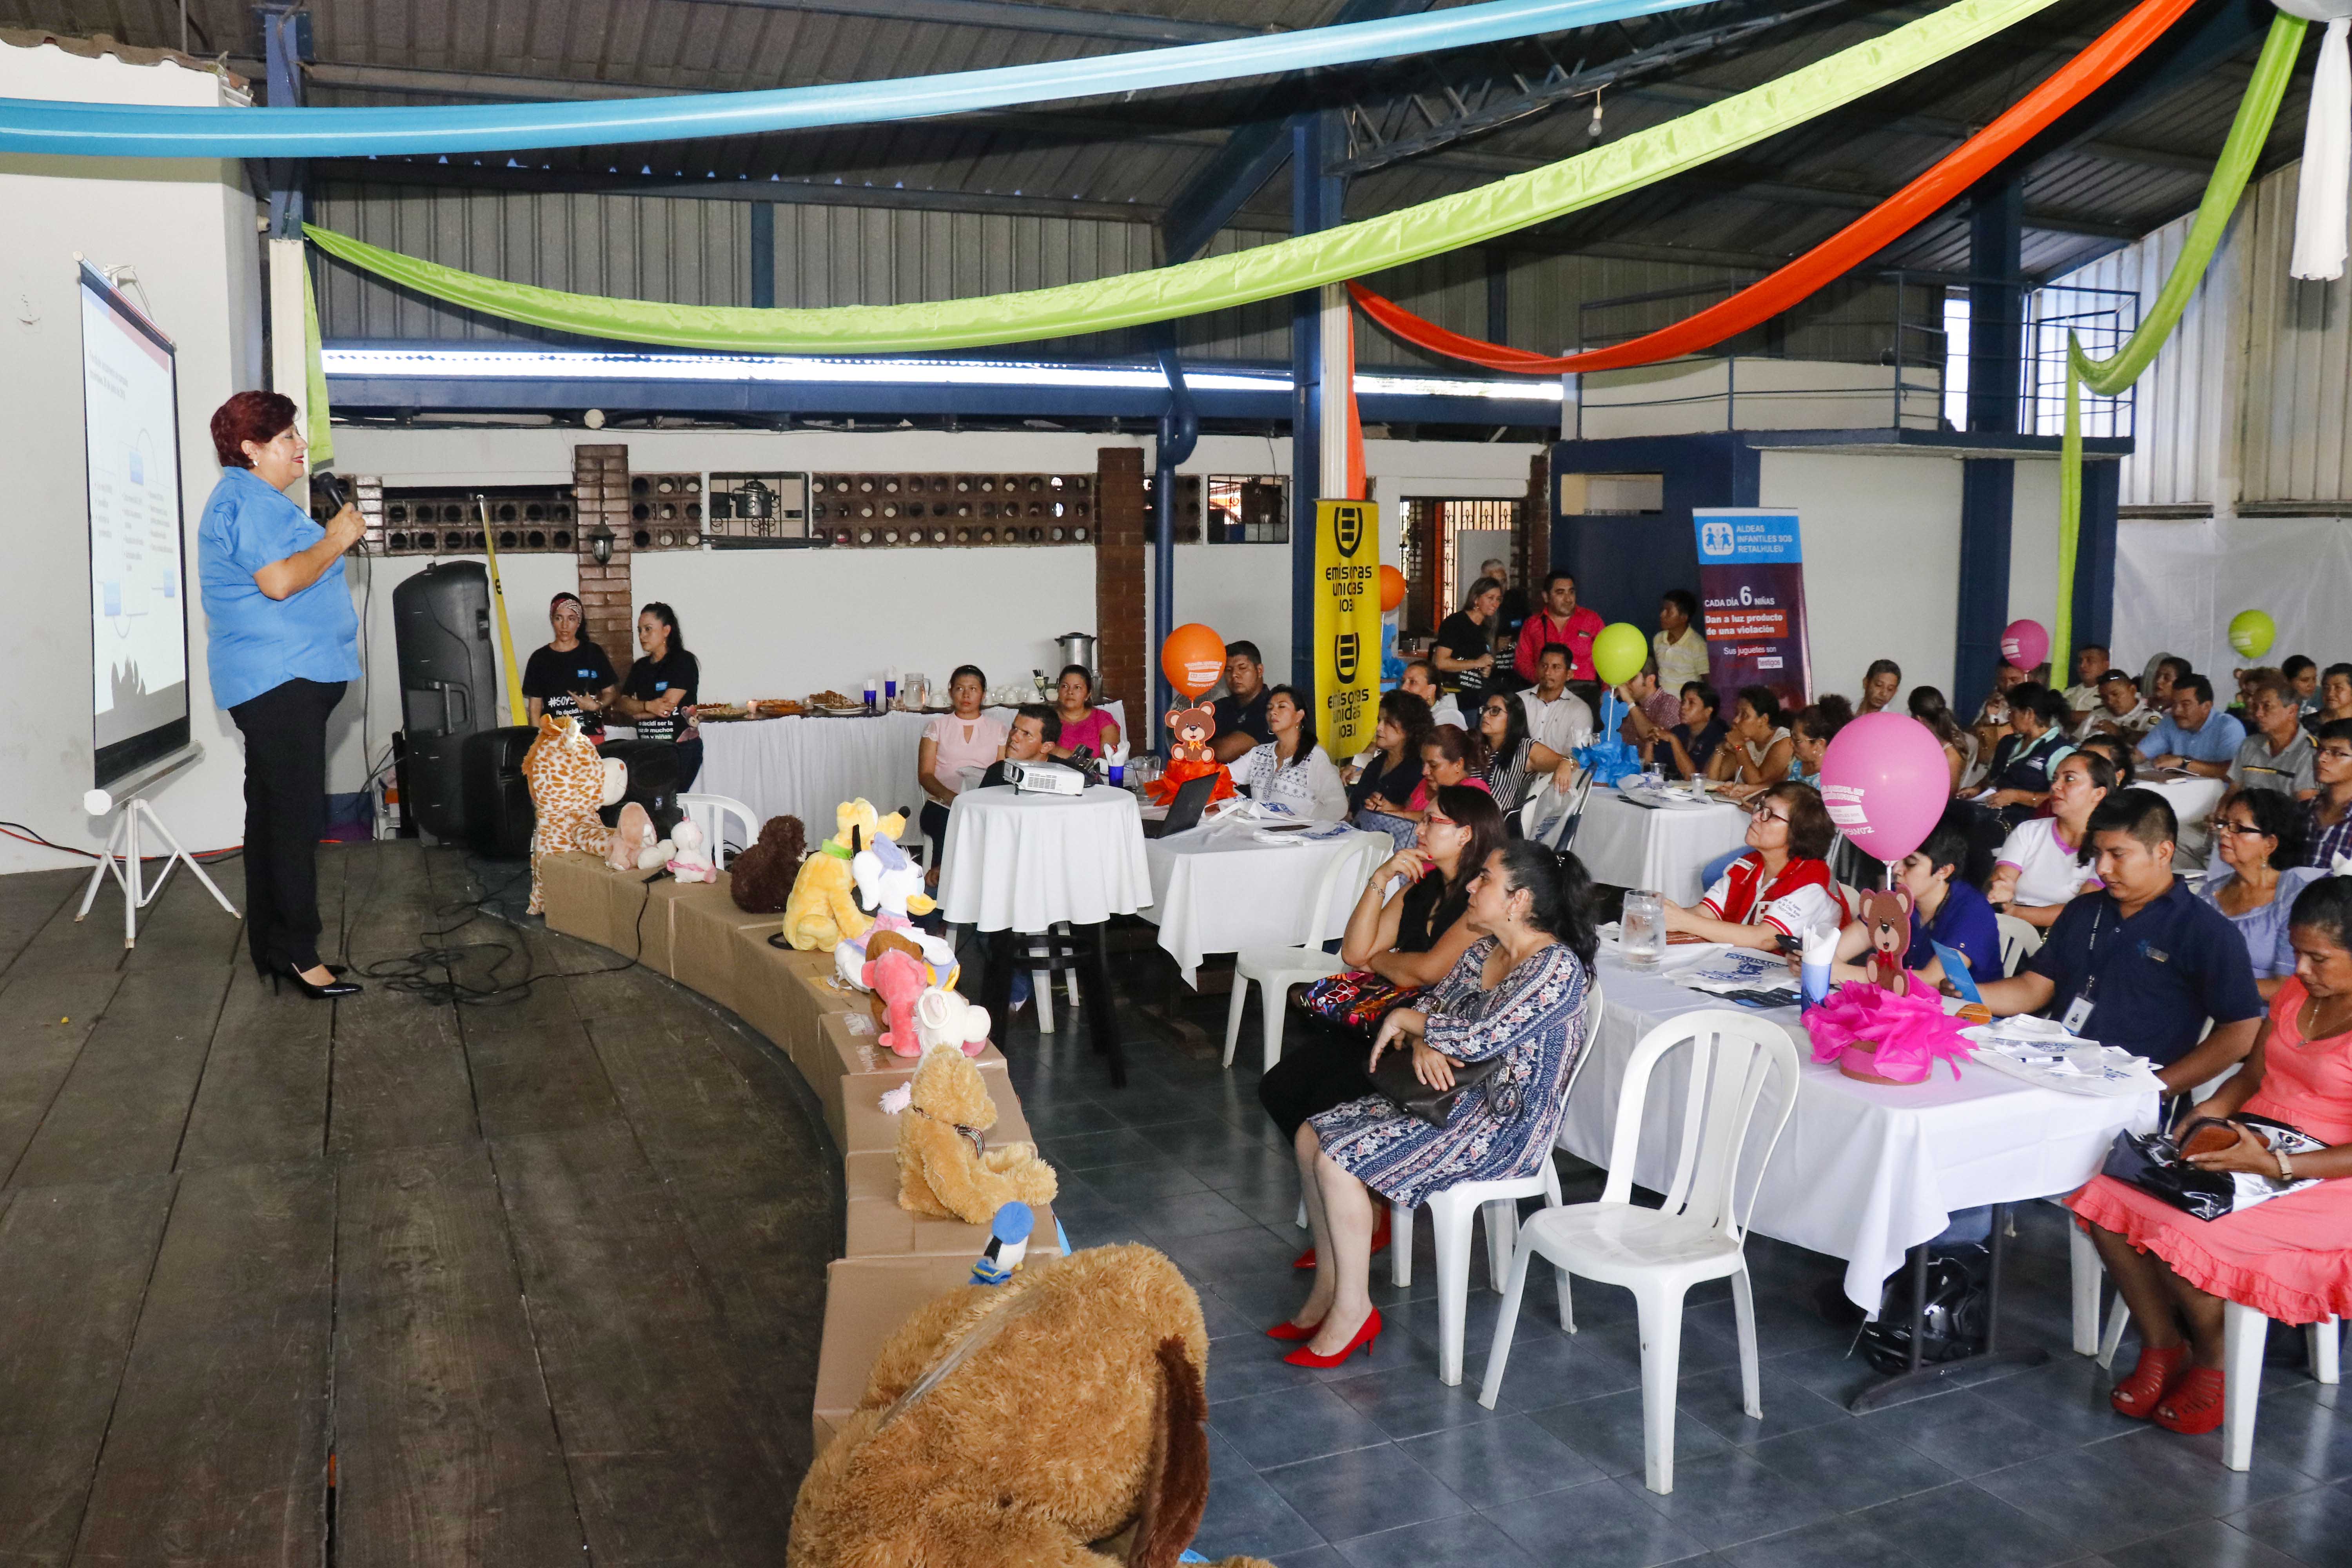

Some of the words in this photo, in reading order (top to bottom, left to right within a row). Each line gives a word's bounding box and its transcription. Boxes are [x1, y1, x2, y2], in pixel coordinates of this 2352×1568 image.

[1726, 597, 1739, 606] DÍA
[1740, 586, 1752, 606] 6
[1754, 596, 1775, 605] NIÑAS
[1706, 615, 1722, 623] Dan
[1746, 613, 1783, 623] producto
[1737, 625, 1775, 634] violación
[1738, 646, 1765, 656] juguetes
